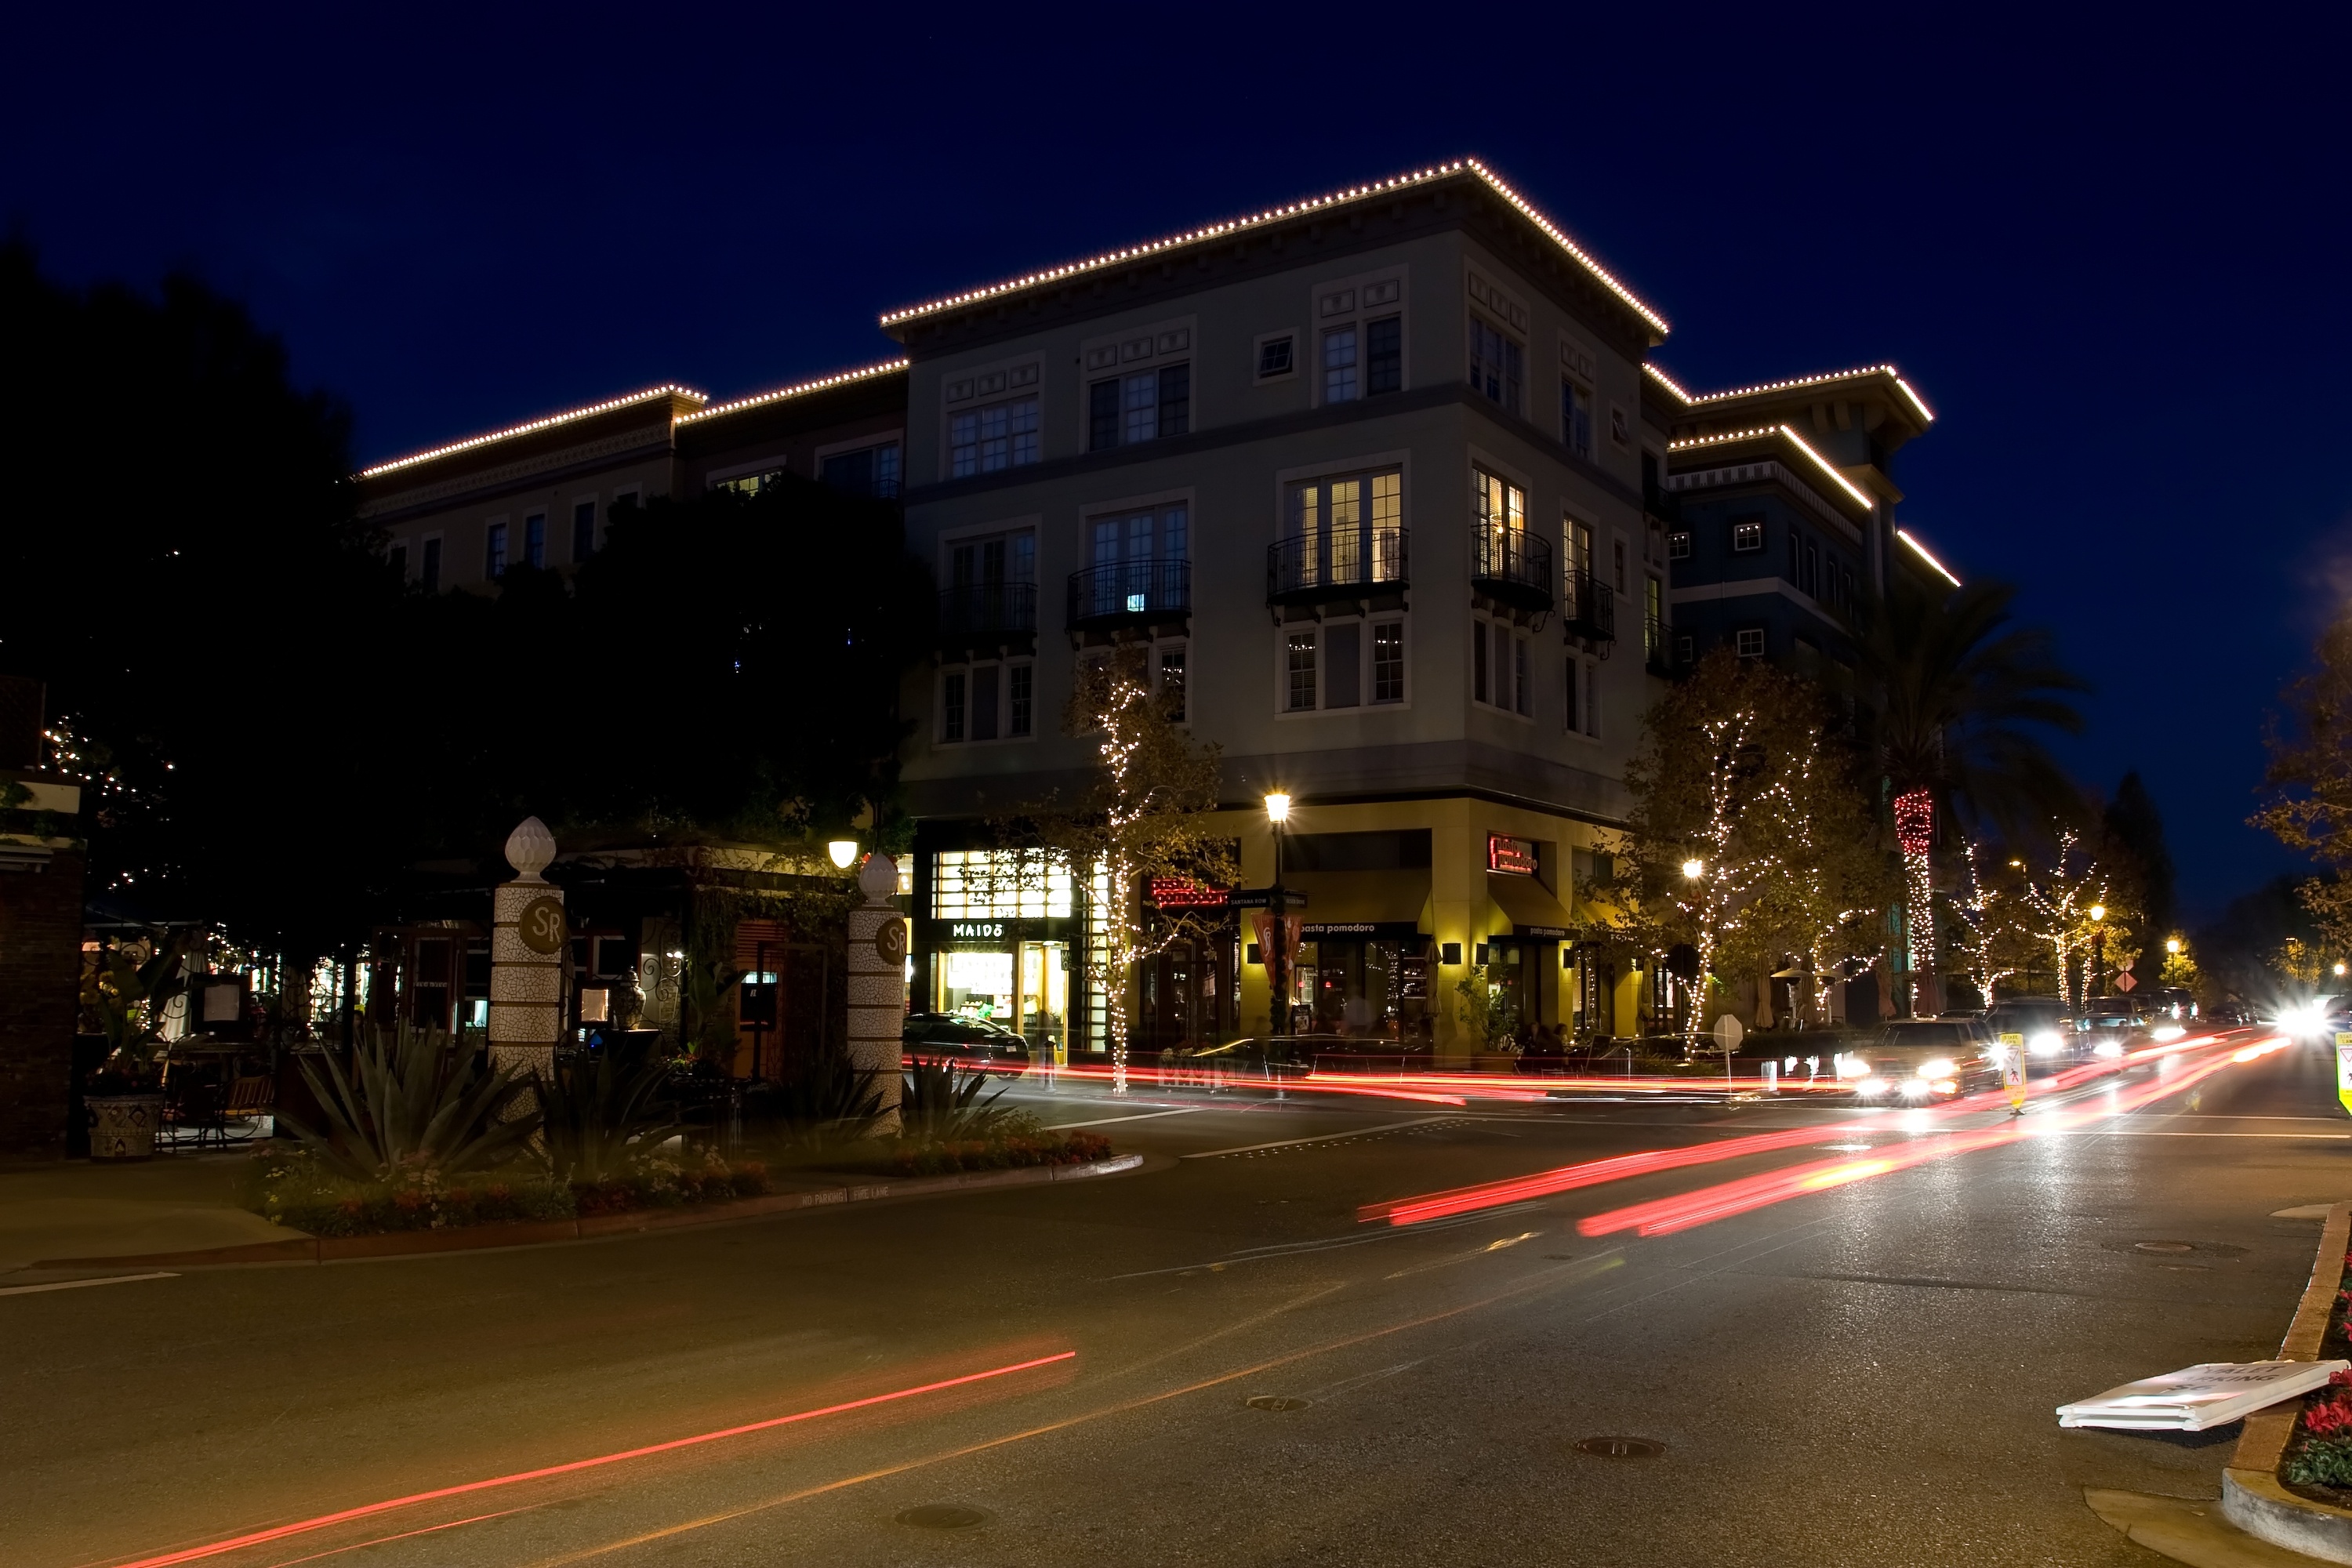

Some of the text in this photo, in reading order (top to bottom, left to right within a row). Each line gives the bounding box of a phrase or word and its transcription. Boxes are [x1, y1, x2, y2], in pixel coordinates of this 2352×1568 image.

[1497, 838, 1518, 853] pasta
[1498, 855, 1538, 870] pomodoro
[532, 906, 561, 943] SR
[1327, 924, 1375, 934] pomodoro
[1543, 928, 1566, 937] pomodoro
[802, 1186, 889, 1207] NO PARKING FIRE LANE
